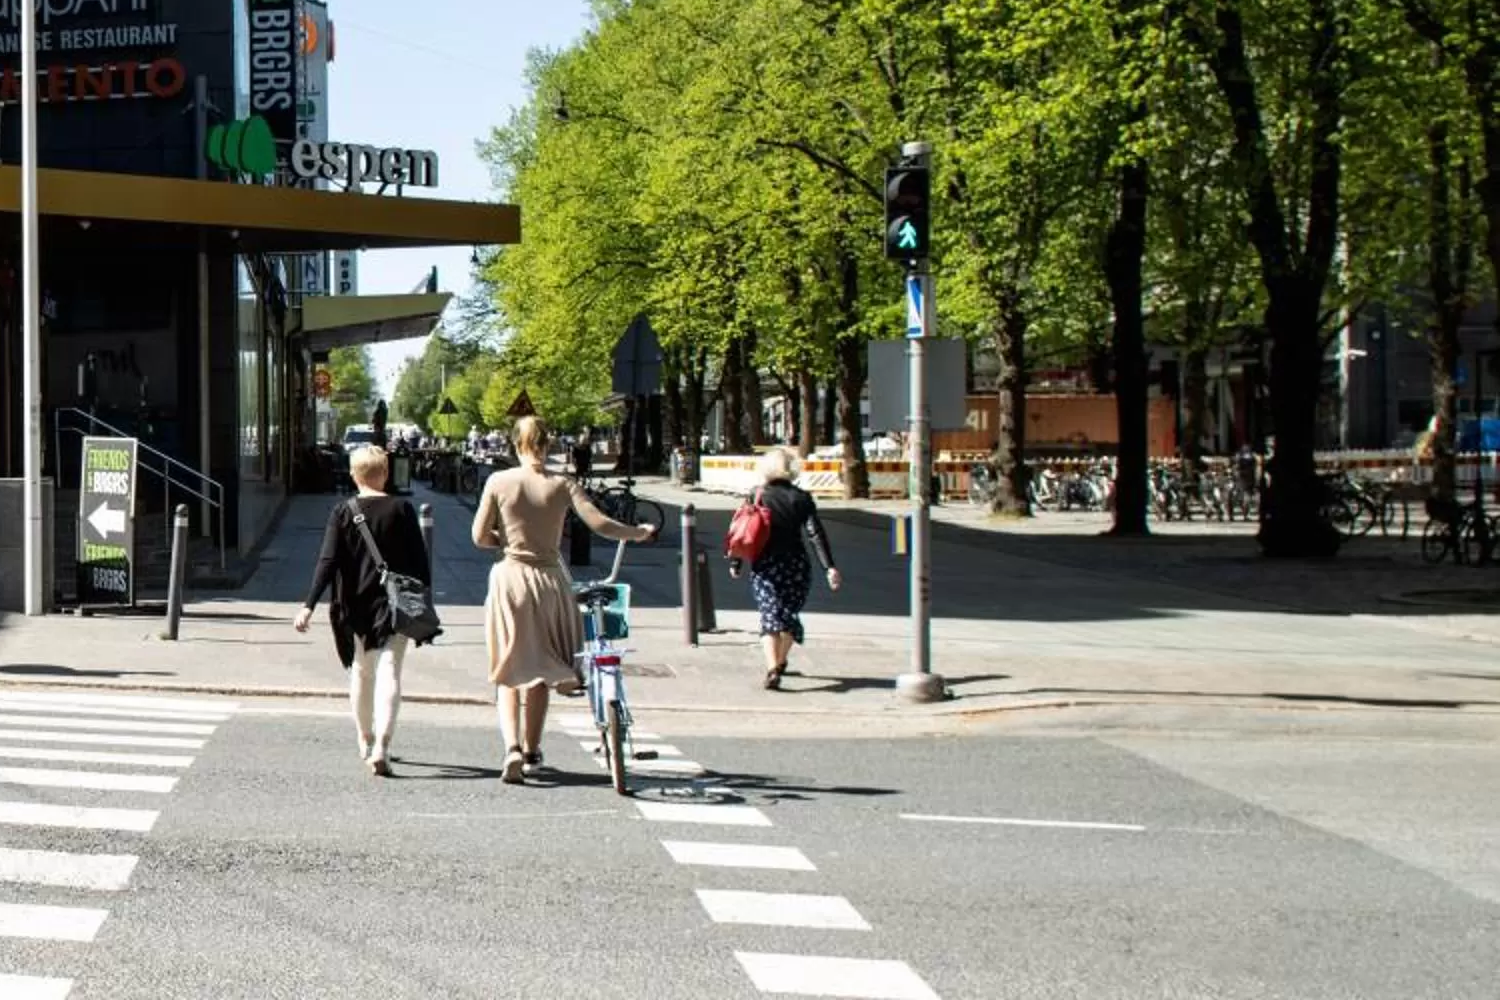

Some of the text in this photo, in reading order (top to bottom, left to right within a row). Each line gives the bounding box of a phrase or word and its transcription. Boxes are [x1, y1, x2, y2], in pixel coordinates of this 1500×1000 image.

[60, 24, 178, 51] RESTAURANT
[251, 8, 291, 112] BRGRS
[291, 138, 438, 194] espen
